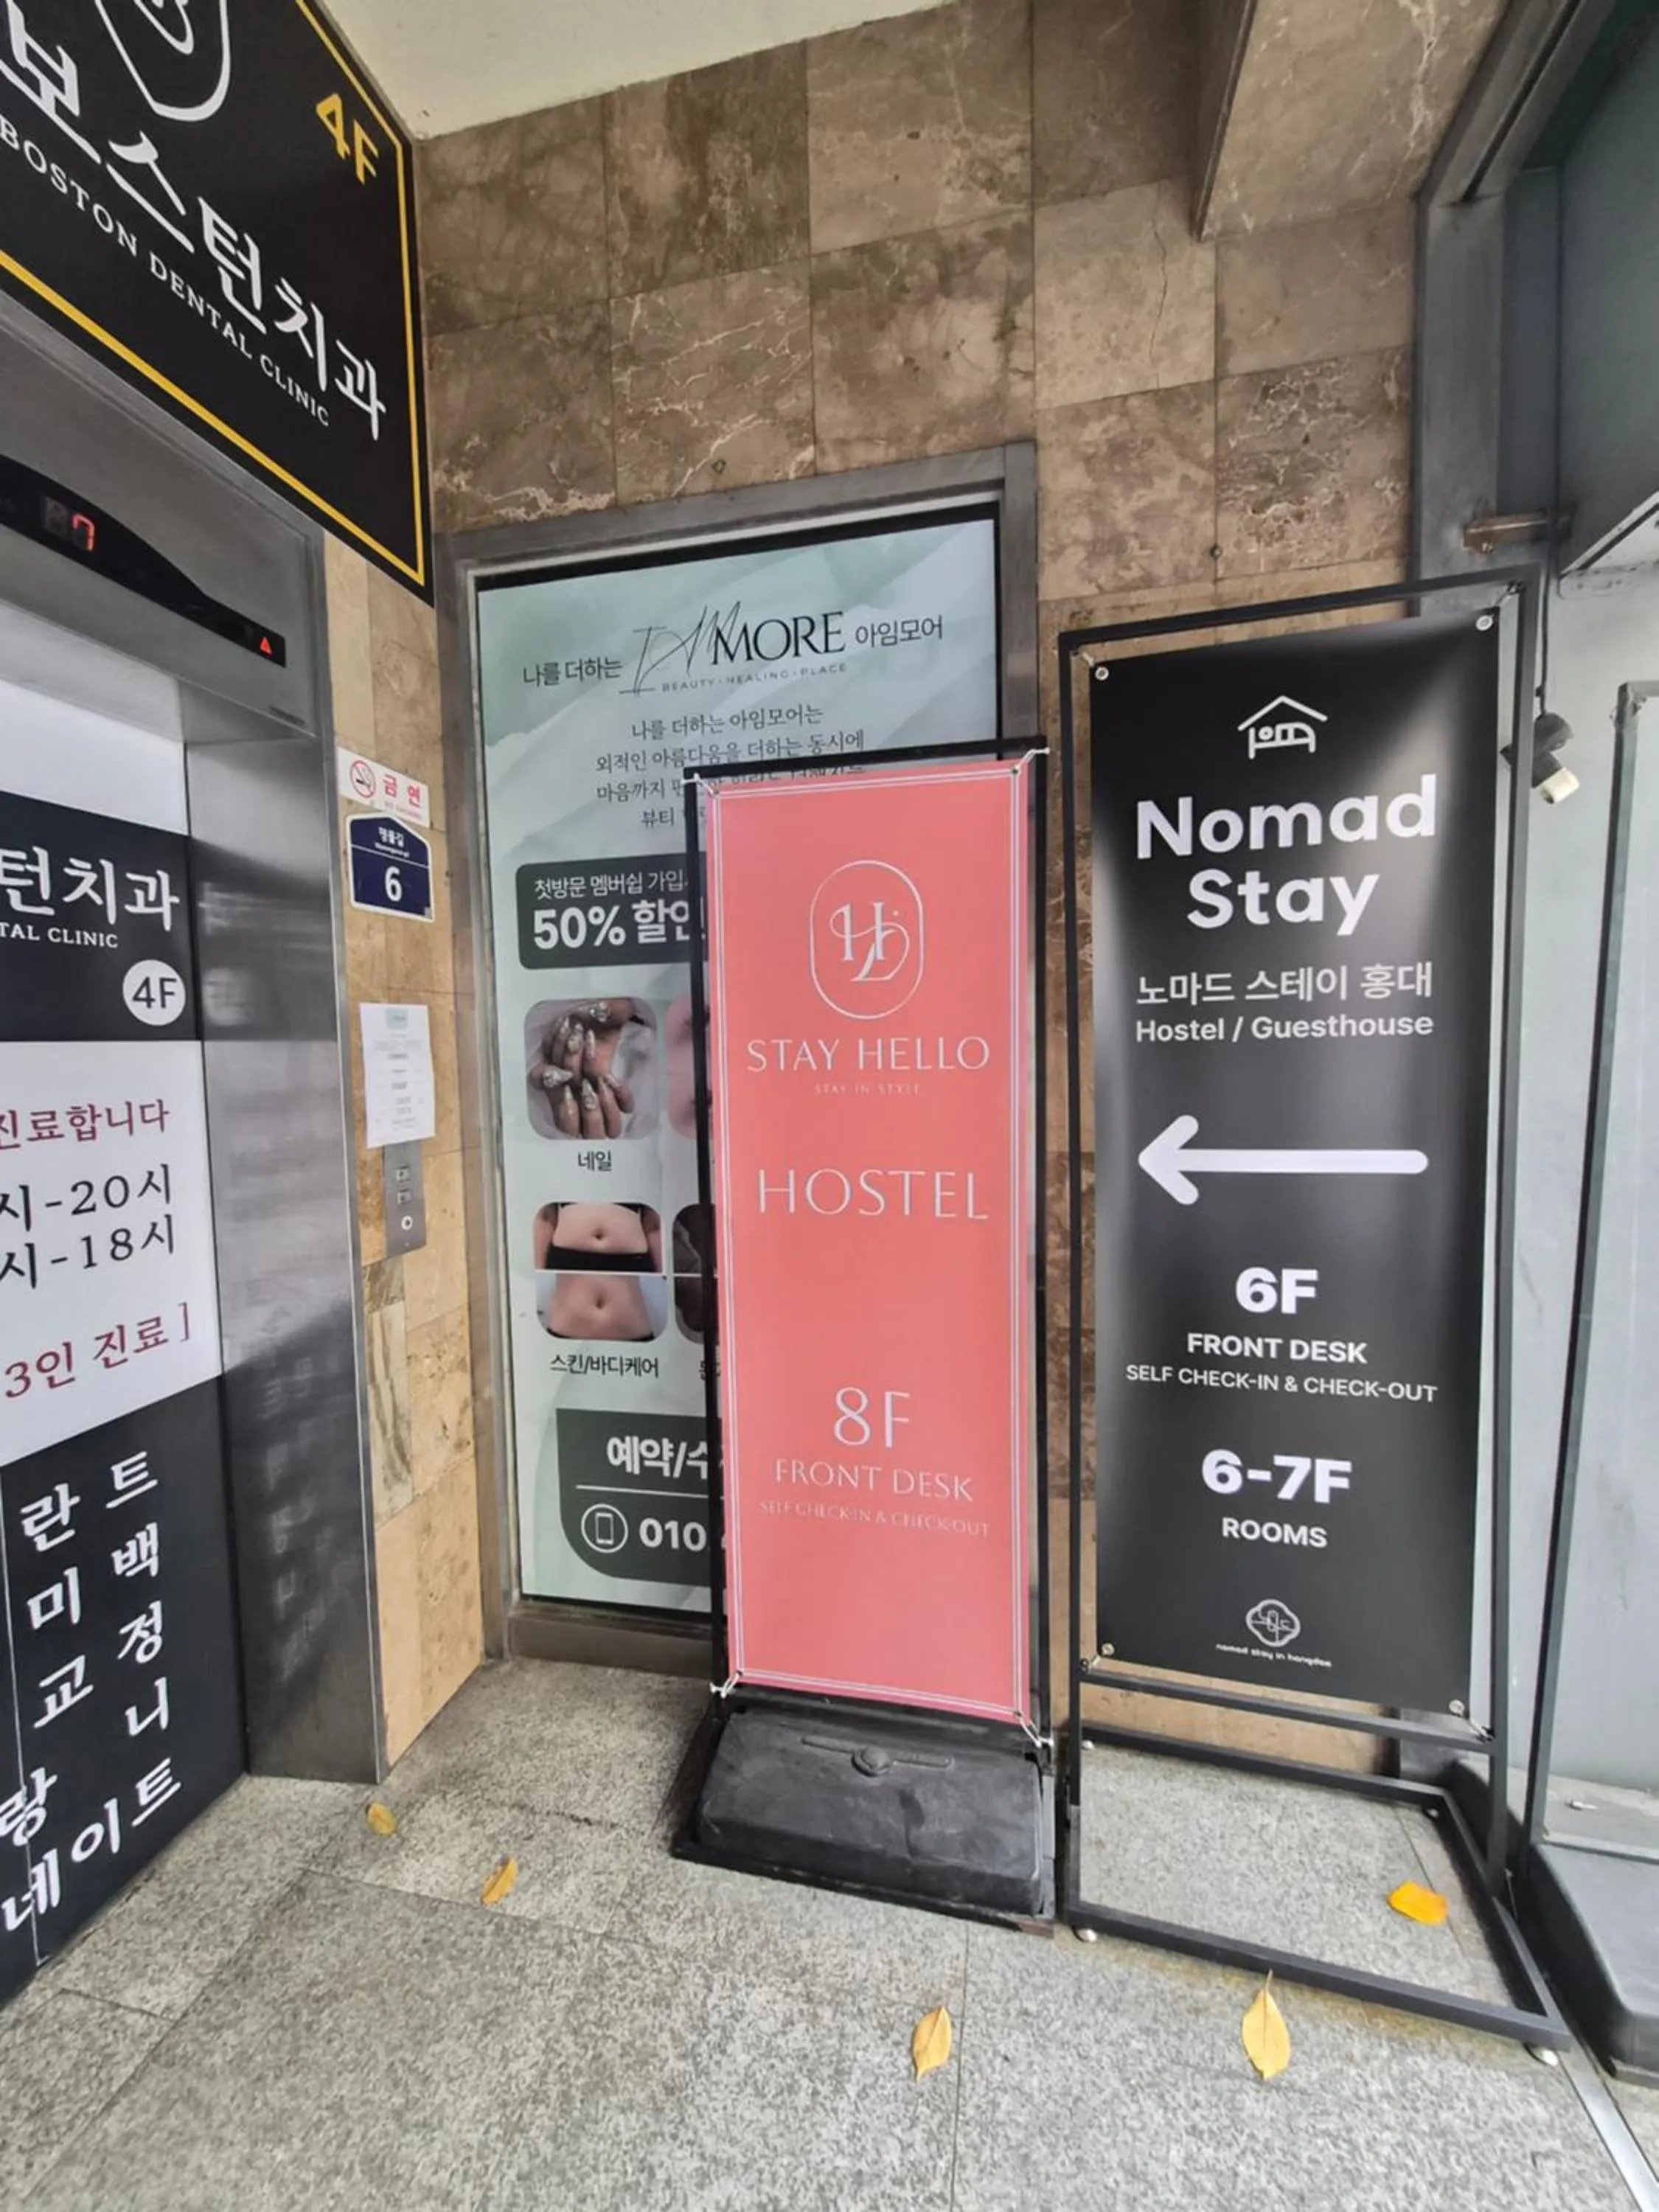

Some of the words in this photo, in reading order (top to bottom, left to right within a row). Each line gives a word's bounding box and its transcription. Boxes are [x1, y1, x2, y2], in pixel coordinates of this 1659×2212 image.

[316, 94, 379, 184] 4F
[0, 114, 137, 257] BOSTON
[150, 251, 252, 360] DENTAL
[260, 354, 329, 426] CLINIC
[523, 661, 560, 686] 나를
[565, 656, 622, 679] 더하는
[855, 615, 943, 648] 아임모어
[632, 720, 664, 741] 나를
[672, 715, 724, 736] 더하는
[730, 704, 824, 731] 아임모어는
[596, 750, 647, 773] 외적인
[652, 742, 741, 768] 아름다움을
[748, 735, 802, 758] 더하는
[807, 729, 864, 755] 동시에
[596, 779, 664, 803] 마음까지
[641, 808, 674, 828] 뷰티
[1136, 773, 1437, 859] Nomad
[0, 846, 180, 932] 턴치과
[384, 866, 403, 902] 6
[535, 877, 586, 900] 첫방문
[647, 869, 689, 892] 가입
[1187, 869, 1380, 936] Stay
[47, 927, 119, 949] CLINIC
[534, 905, 627, 950] 50%
[131, 976, 177, 1009] 4F
[1136, 972, 1236, 1006] 노마드
[1245, 965, 1348, 1002] 스테이
[1360, 961, 1433, 1000] 홍대
[1136, 1018, 1225, 1043] Hostel
[1251, 1015, 1433, 1040] Guesthouse
[747, 1038, 840, 1073] STAY
[858, 1036, 990, 1071] HELLO
[0, 1098, 170, 1150] 진료합니다
[577, 1150, 613, 1172] 네일
[759, 1168, 989, 1220] HOSTEL
[1235, 1266, 1318, 1315] 6F
[4, 1341, 76, 1399] 3인
[550, 1354, 659, 1378] 스킨/바디케어
[1186, 1332, 1283, 1359] FRONT
[1289, 1340, 1368, 1364] DESK
[1126, 1364, 1173, 1382] SELF
[1178, 1368, 1279, 1391] CHECK-IN
[1284, 1377, 1298, 1392] &
[1303, 1377, 1439, 1402] CHECK-OUT
[832, 1386, 911, 1449] 8F
[775, 1458, 883, 1492] FRONT
[893, 1468, 973, 1503] DESK
[1202, 1448, 1352, 1504] 6-7F
[759, 1500, 791, 1513] SELF
[1222, 1517, 1328, 1548] ROOMS
